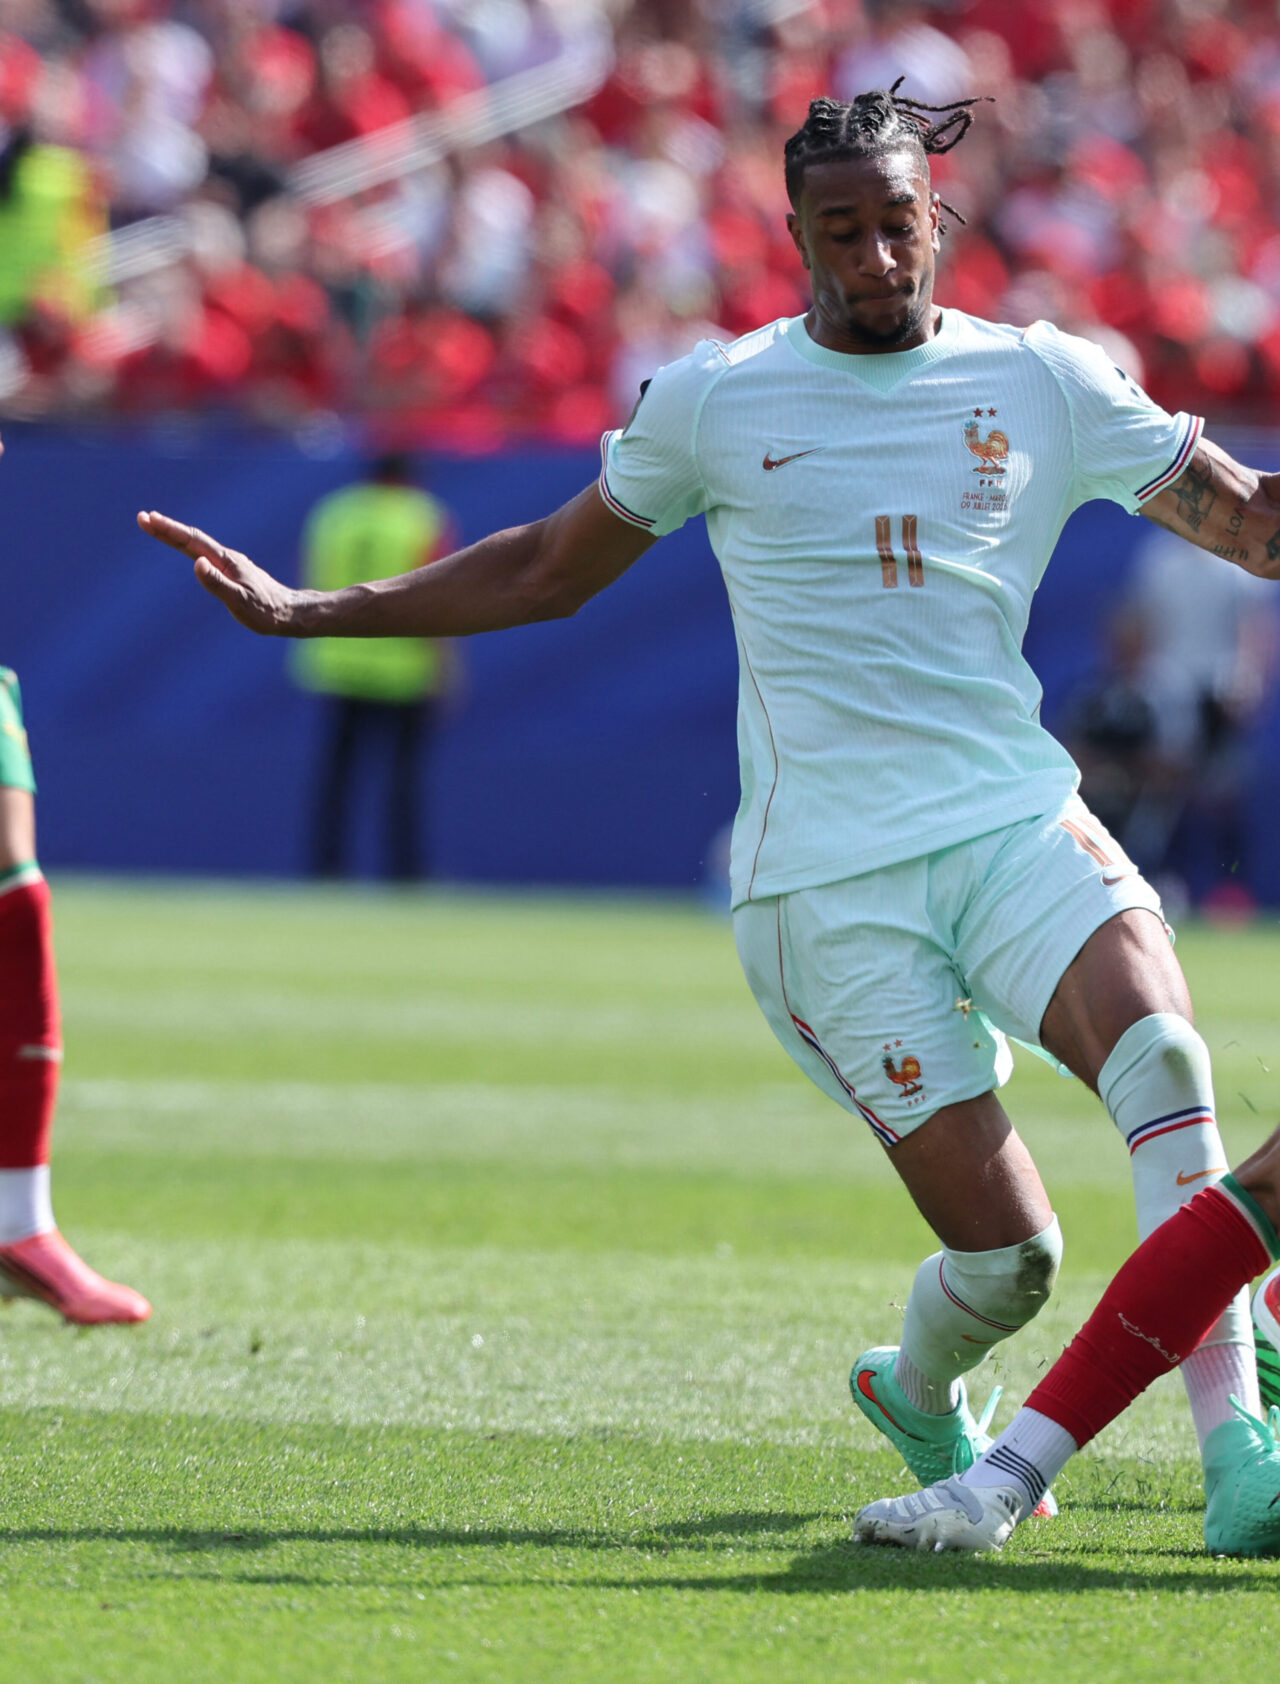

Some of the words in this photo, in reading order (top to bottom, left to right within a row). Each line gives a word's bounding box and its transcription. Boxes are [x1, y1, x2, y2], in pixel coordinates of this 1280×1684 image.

[962, 492, 985, 501] FRANCE
[960, 500, 971, 510] 09
[874, 514, 925, 589] 11
